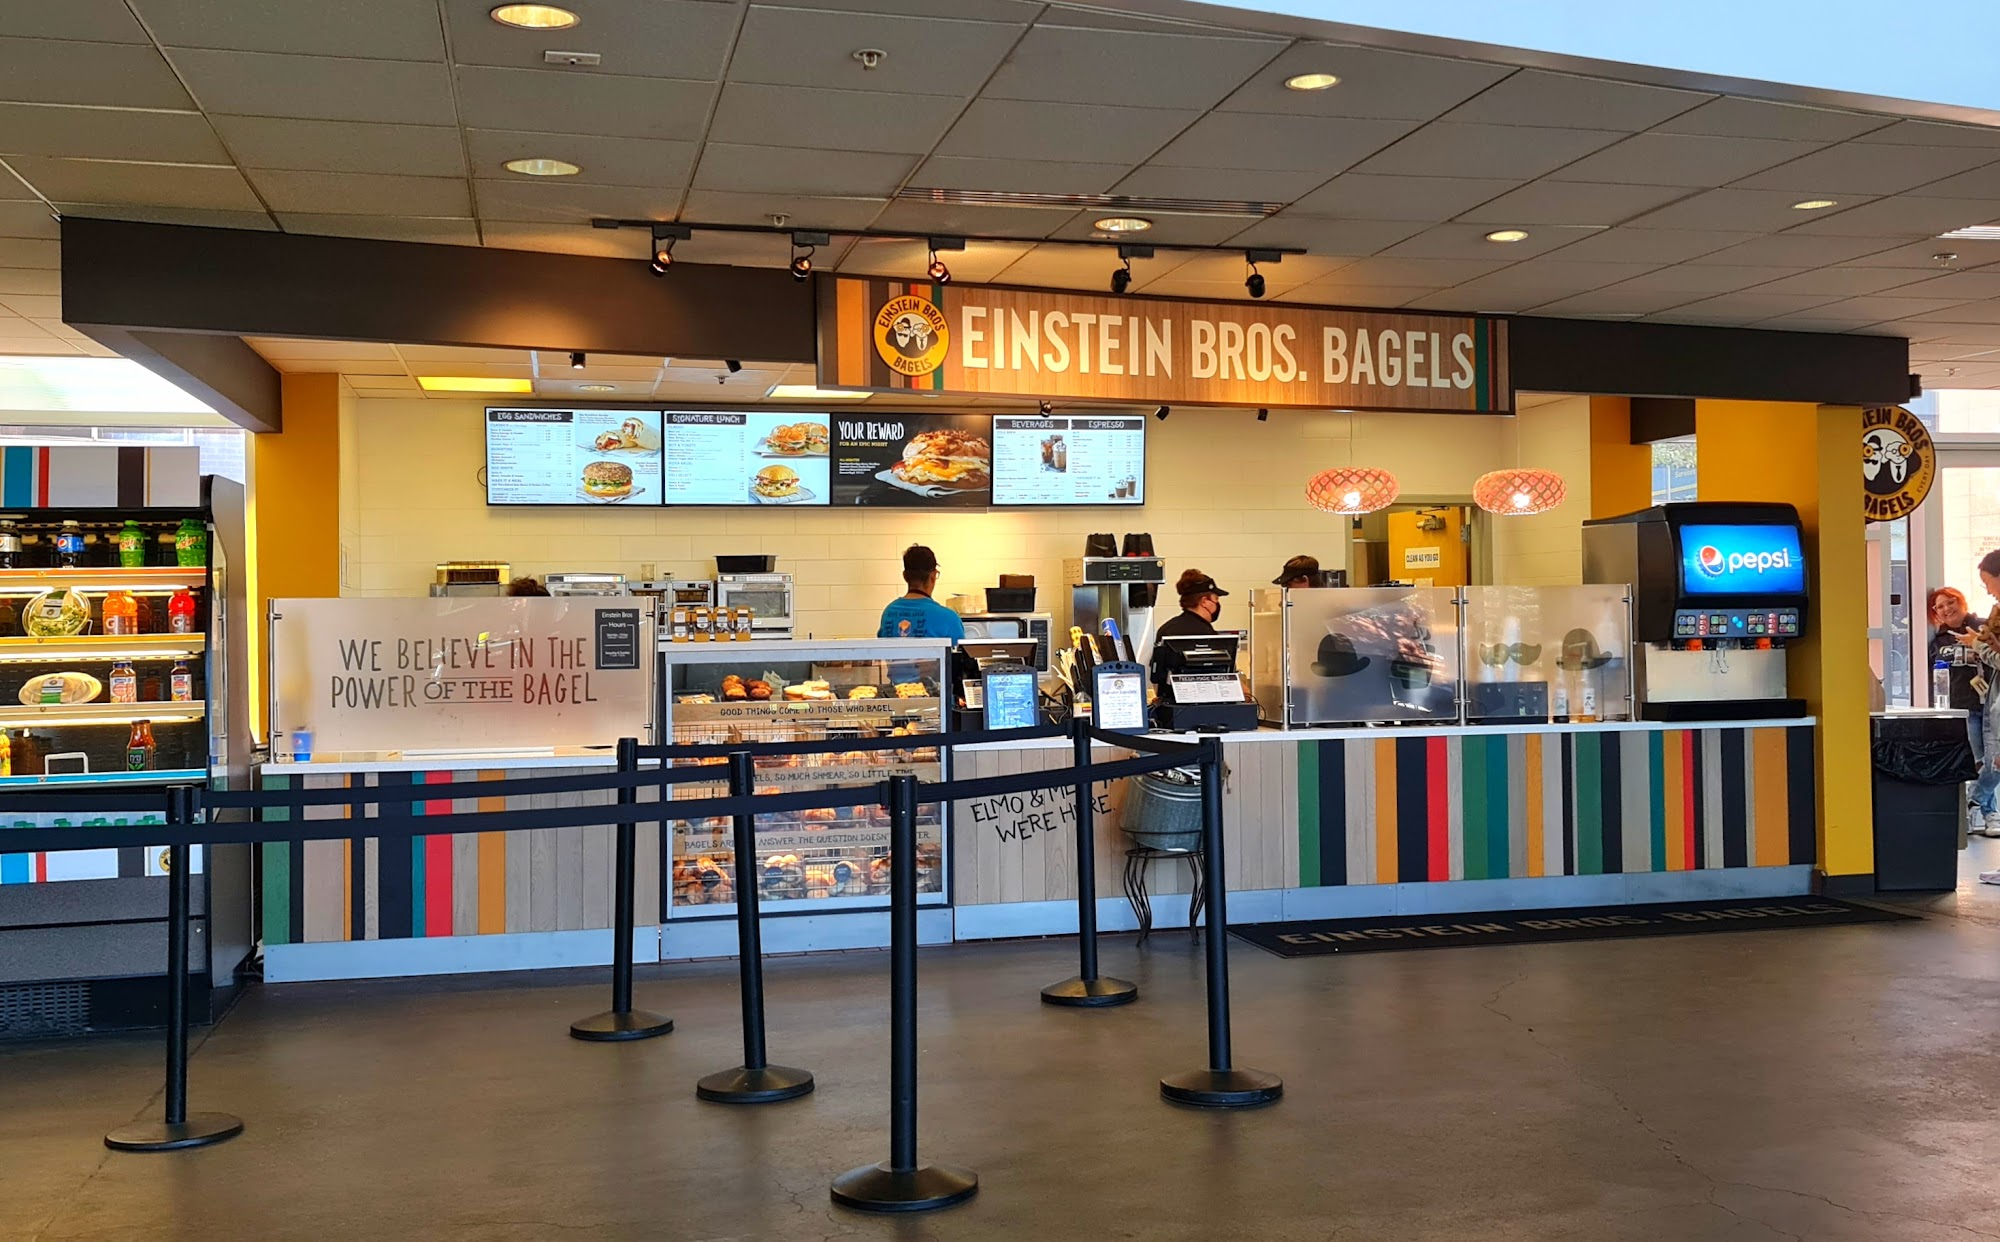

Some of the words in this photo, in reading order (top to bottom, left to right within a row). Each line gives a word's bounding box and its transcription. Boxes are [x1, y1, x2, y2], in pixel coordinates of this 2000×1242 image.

[878, 298, 920, 328] EINSTEIN
[922, 304, 946, 332] BROS
[961, 305, 1172, 380] EINSTEIN
[1190, 319, 1308, 382] BROS.
[1323, 326, 1475, 389] BAGELS
[893, 356, 933, 373] BAGELS
[497, 412, 512, 420] EGG
[514, 412, 562, 421] SANDWICHES
[672, 414, 714, 423] SIGNATURE
[716, 415, 740, 424] LUNCH
[1011, 420, 1054, 429] BEVERAGES
[1088, 420, 1125, 429] ESPRESSO
[838, 421, 865, 441] YOUR
[866, 422, 905, 441] REWARD
[1895, 412, 1930, 451] BROS
[1864, 491, 1915, 515] BAGELS
[1418, 554, 1424, 562] AS
[1424, 553, 1432, 562] YOU
[1728, 547, 1789, 574] pepsi
[338, 638, 382, 672] WE
[397, 637, 496, 671] BELIEVE
[509, 637, 535, 670] IN
[547, 636, 587, 669] THE
[331, 674, 417, 709] POWER
[424, 682, 456, 701] OF
[462, 681, 513, 700] THE
[523, 672, 598, 706] BAGEL
[720, 708, 743, 716] GOOD
[746, 707, 777, 715] THINGS
[779, 706, 800, 715] COME
[817, 705, 843, 714] THOSE
[846, 704, 864, 713] WHO
[775, 773, 786, 782] SO
[788, 772, 810, 781] MUCH
[849, 769, 860, 778] SO
[862, 769, 893, 779] LITTLE
[970, 794, 1024, 822] ELMO
[1030, 789, 1044, 808] &
[995, 811, 1057, 843] WERE
[685, 839, 718, 850] BAGELS
[759, 836, 795, 846] ANSWER
[798, 836, 814, 844] THE
[816, 834, 858, 843] QUESTION
[1276, 921, 1515, 946] EINSTEIN
[1516, 914, 1662, 932] BROS.
[1660, 902, 1853, 923] BAGELS
